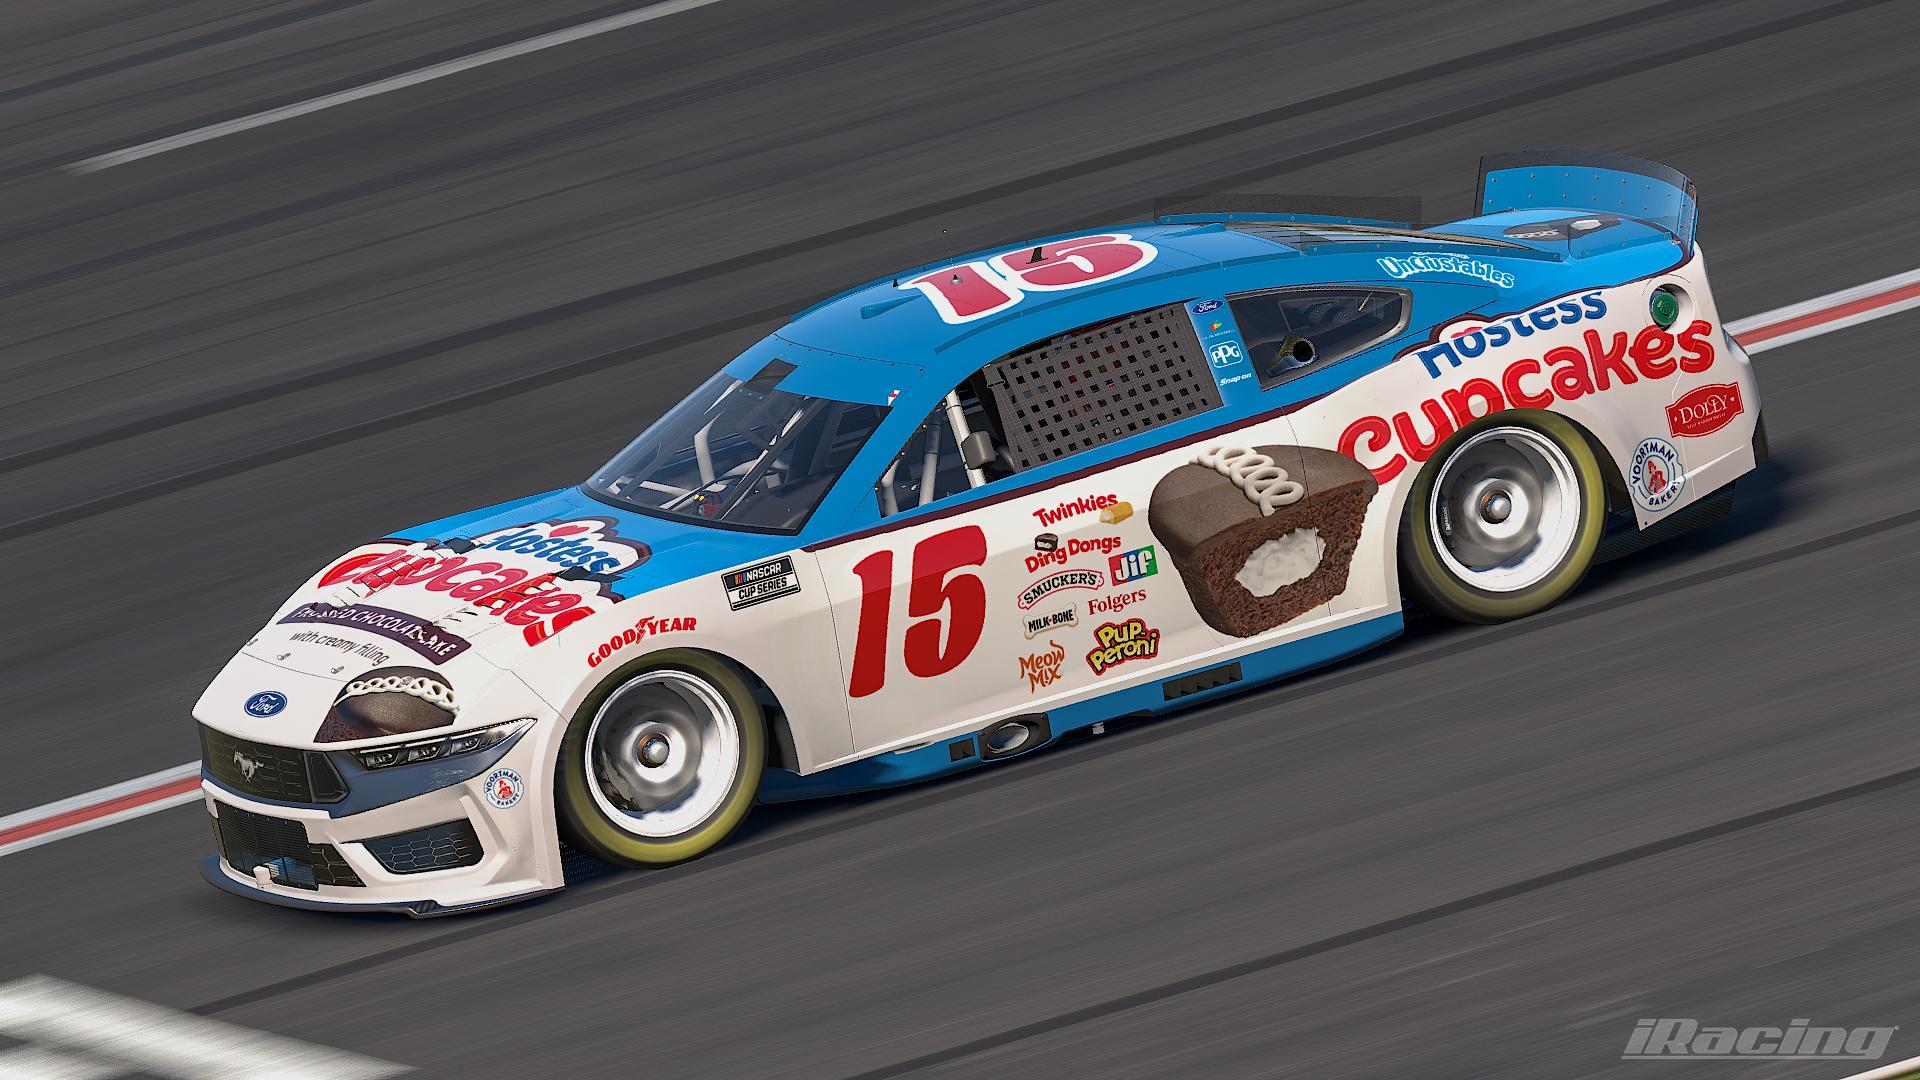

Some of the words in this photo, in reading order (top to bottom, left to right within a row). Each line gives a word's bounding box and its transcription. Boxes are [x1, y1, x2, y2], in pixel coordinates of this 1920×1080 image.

[898, 234, 1159, 325] 15
[1198, 301, 1218, 312] Ford
[1212, 345, 1240, 363] PPG
[1220, 373, 1252, 386] Snap-on
[1338, 319, 1716, 485] Cupcakes
[1679, 394, 1728, 424] DOLLY
[1632, 441, 1675, 484] VOORTMAN
[1033, 493, 1119, 527] Twinkies
[1024, 544, 1068, 573] Ding
[1067, 536, 1122, 555] Dongs
[1114, 549, 1153, 581] Jif
[739, 585, 756, 599] CUP
[757, 577, 788, 594] SERIES
[746, 562, 782, 582] NASCAR
[1023, 571, 1098, 604] SMUCKER'S
[849, 525, 988, 698] 15
[1087, 589, 1147, 616] Folgers
[290, 630, 320, 643] with
[315, 635, 360, 654] creamy
[354, 643, 390, 667] filling
[587, 616, 698, 668] GOODYEAR
[250, 694, 280, 713] Ford
[486, 770, 519, 792] VOORTMAN
